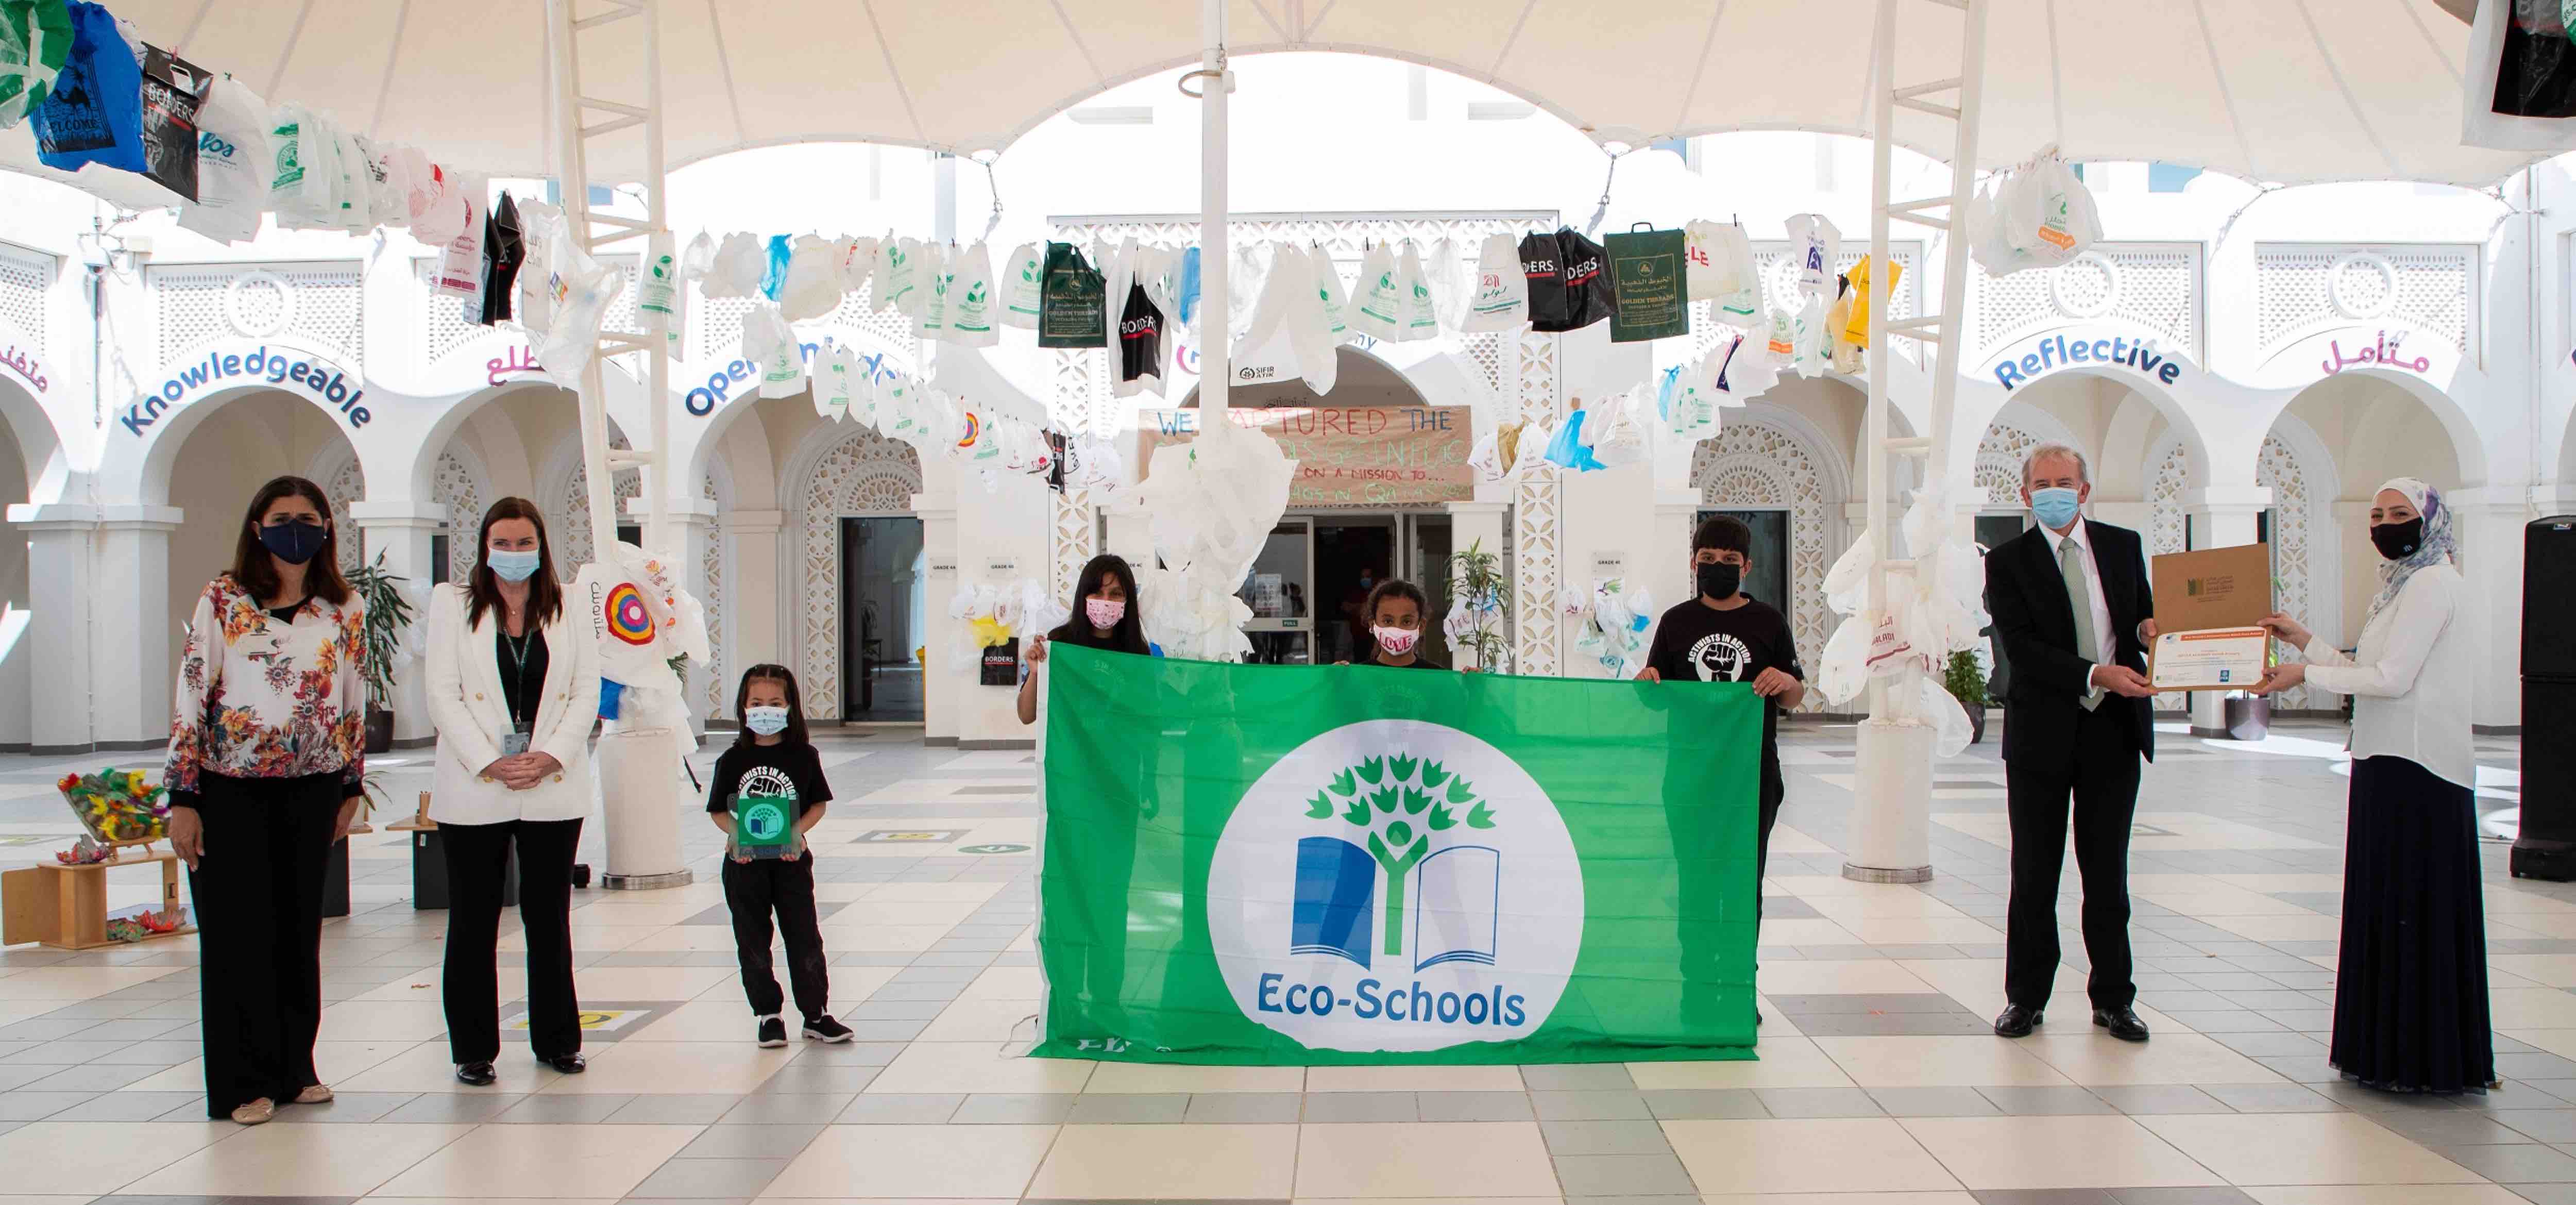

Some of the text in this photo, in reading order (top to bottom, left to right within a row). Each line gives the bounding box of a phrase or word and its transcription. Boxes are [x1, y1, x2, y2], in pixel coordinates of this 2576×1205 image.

[50, 119, 98, 132] ELCOME
[487, 345, 546, 386] طلع
[1994, 335, 2180, 391] Reflective
[2322, 330, 2430, 375] متأمل
[122, 346, 371, 438] Knowledgeable
[1158, 408, 1452, 437] WE APTURED THE
[1304, 467, 1326, 479] ON
[1351, 468, 1403, 481] MISSION
[1378, 631, 1412, 652] LOVE
[1687, 633, 1752, 663] ACTIVISTS IN ACTION
[769, 766, 779, 777] IN
[777, 772, 797, 800] ACTION
[1258, 972, 1526, 1027] Eco-Schools
